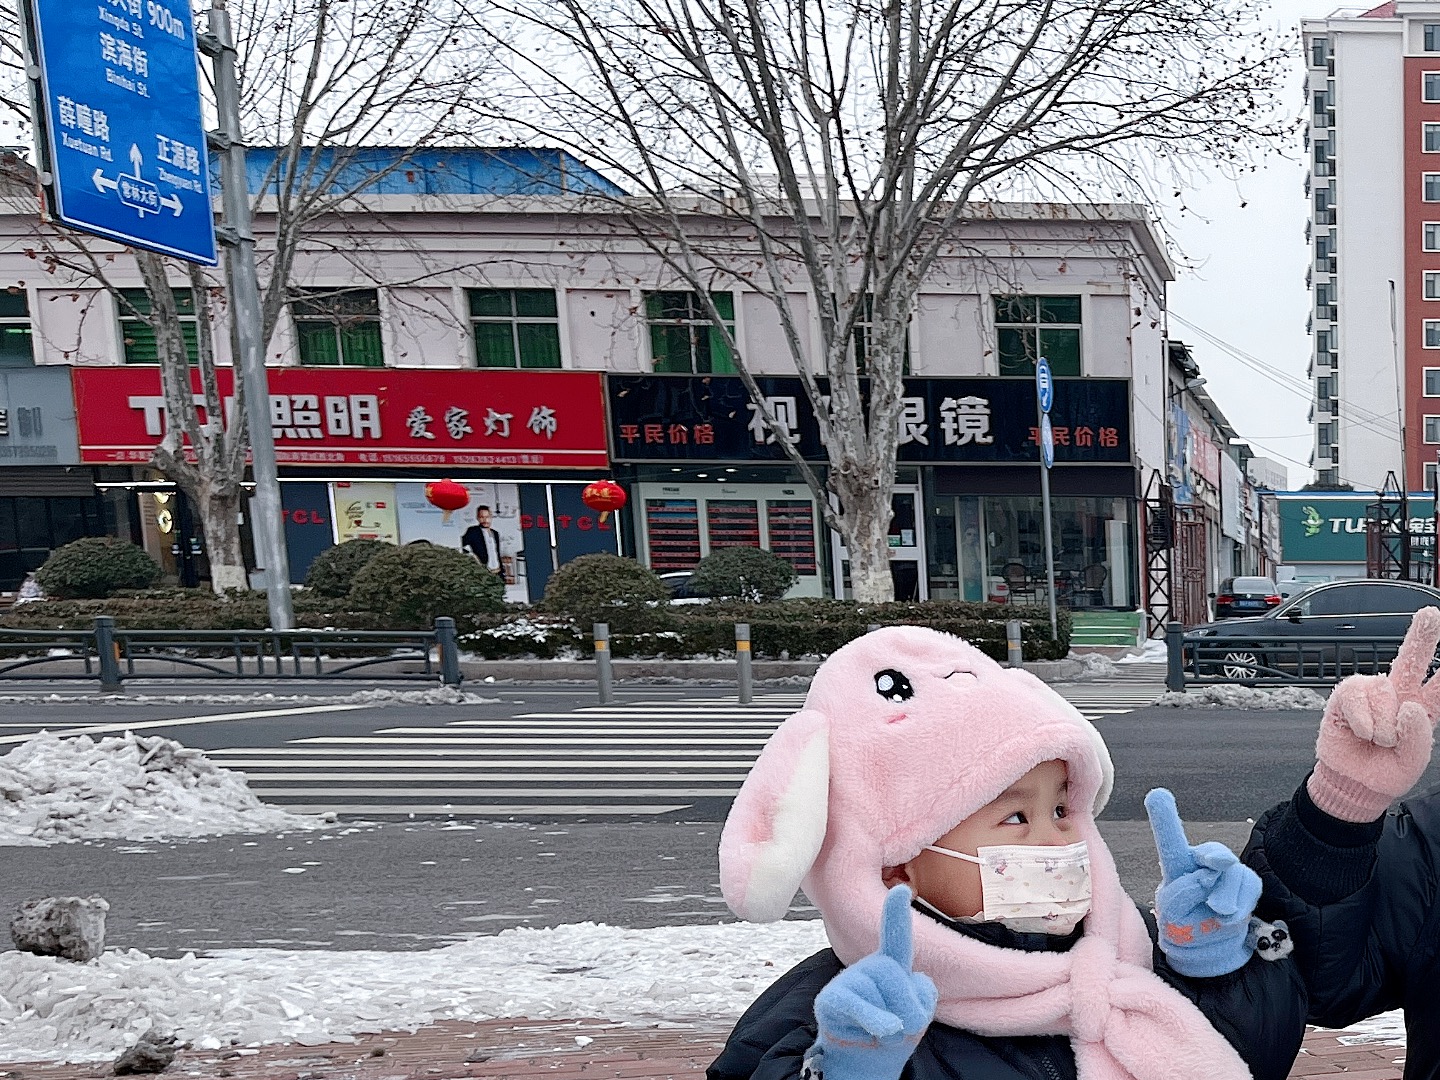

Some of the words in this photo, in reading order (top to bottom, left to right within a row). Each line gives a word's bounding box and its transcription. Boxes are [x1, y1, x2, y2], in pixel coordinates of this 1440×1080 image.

[147, 1, 185, 40] 900m
[100, 32, 148, 77] 滨海街
[155, 134, 200, 175] 正源路
[405, 405, 558, 440] 爱家灯饰
[619, 423, 715, 445] 平民价格
[746, 394, 994, 446] 视眼镜
